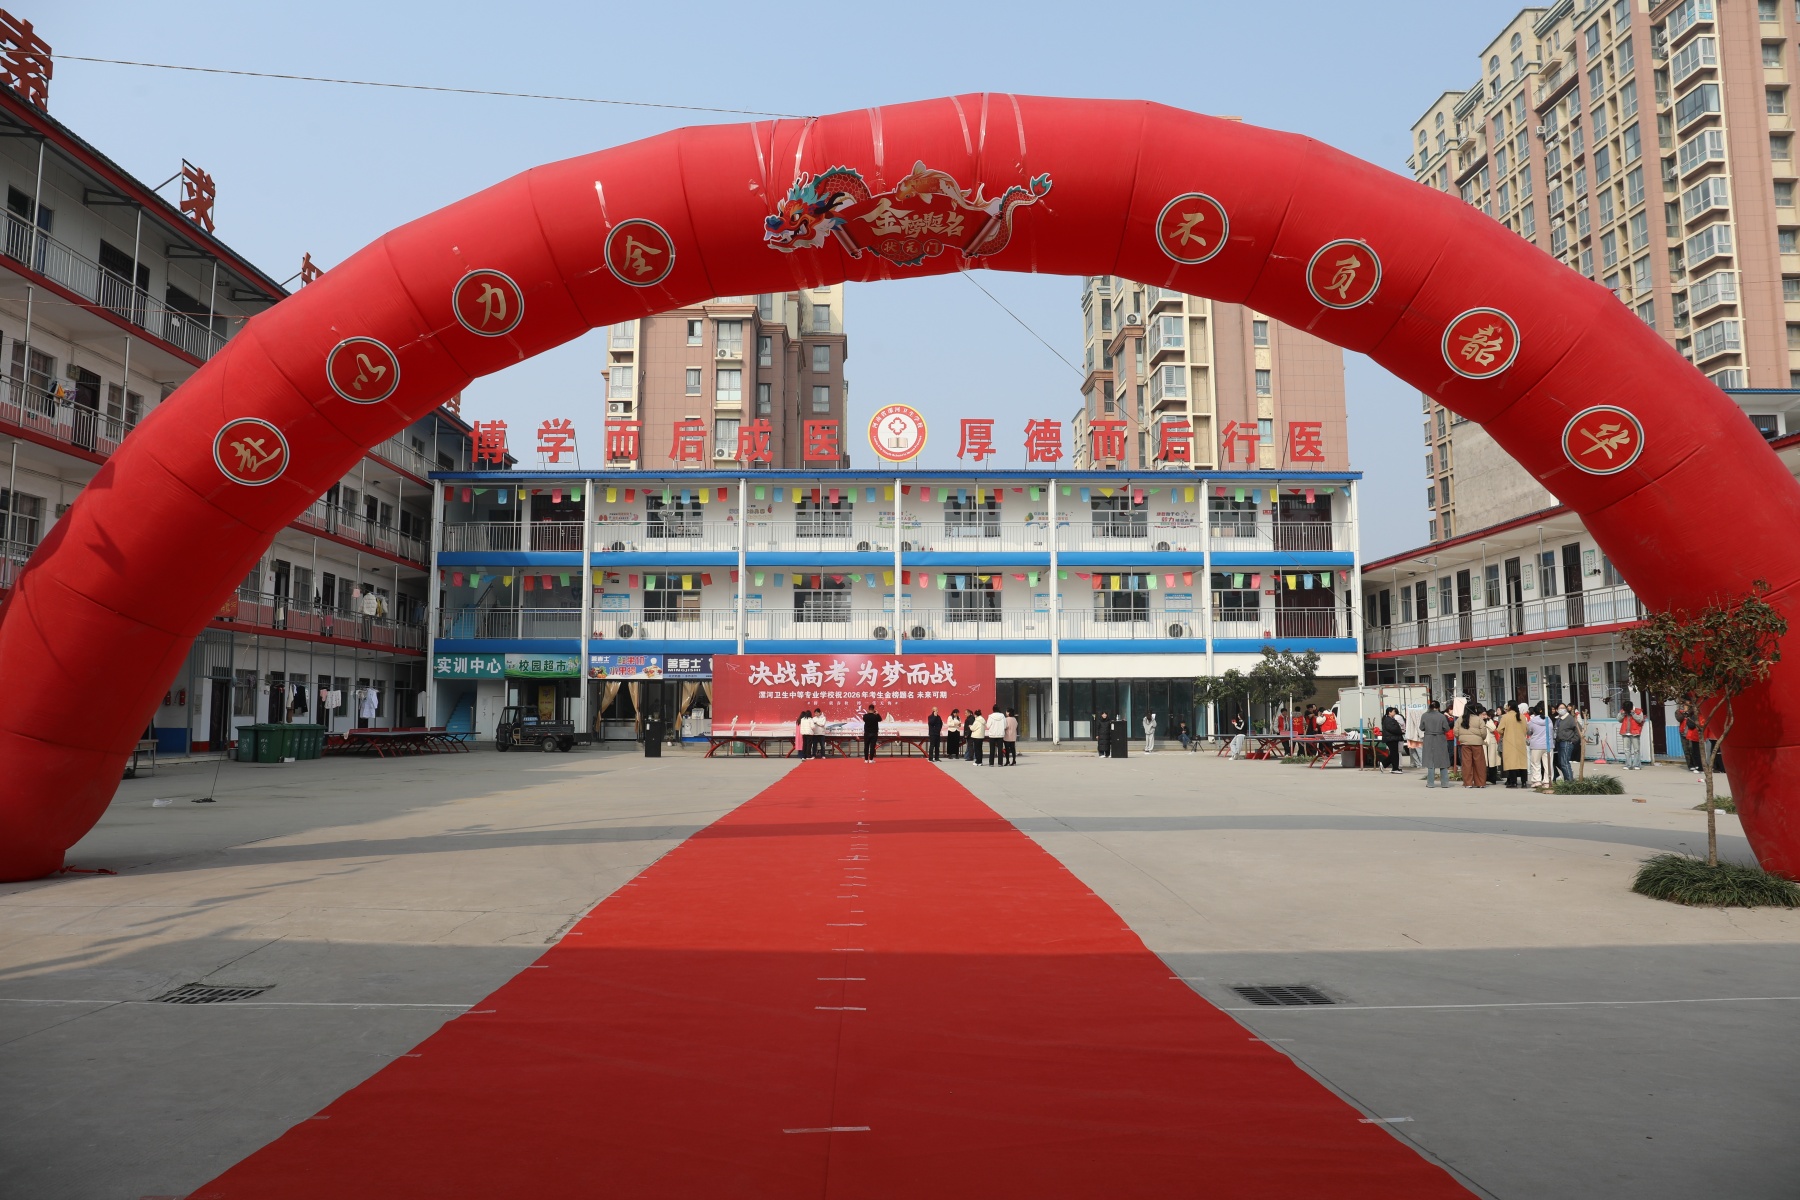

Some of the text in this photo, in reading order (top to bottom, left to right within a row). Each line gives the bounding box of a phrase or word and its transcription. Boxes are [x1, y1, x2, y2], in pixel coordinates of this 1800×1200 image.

[853, 197, 965, 238] 金榜题名
[883, 241, 942, 254] 状元门
[470, 417, 841, 464] 博学而后成医
[956, 418, 1326, 464] 厚德而后行医
[437, 656, 502, 674] 实训中心
[518, 659, 566, 673] 校园超市
[748, 660, 957, 688] 决战高考 为梦而战
[758, 690, 948, 700] 漯河卫生中等专业学校祝2026年考生金榜题名 未来可期
